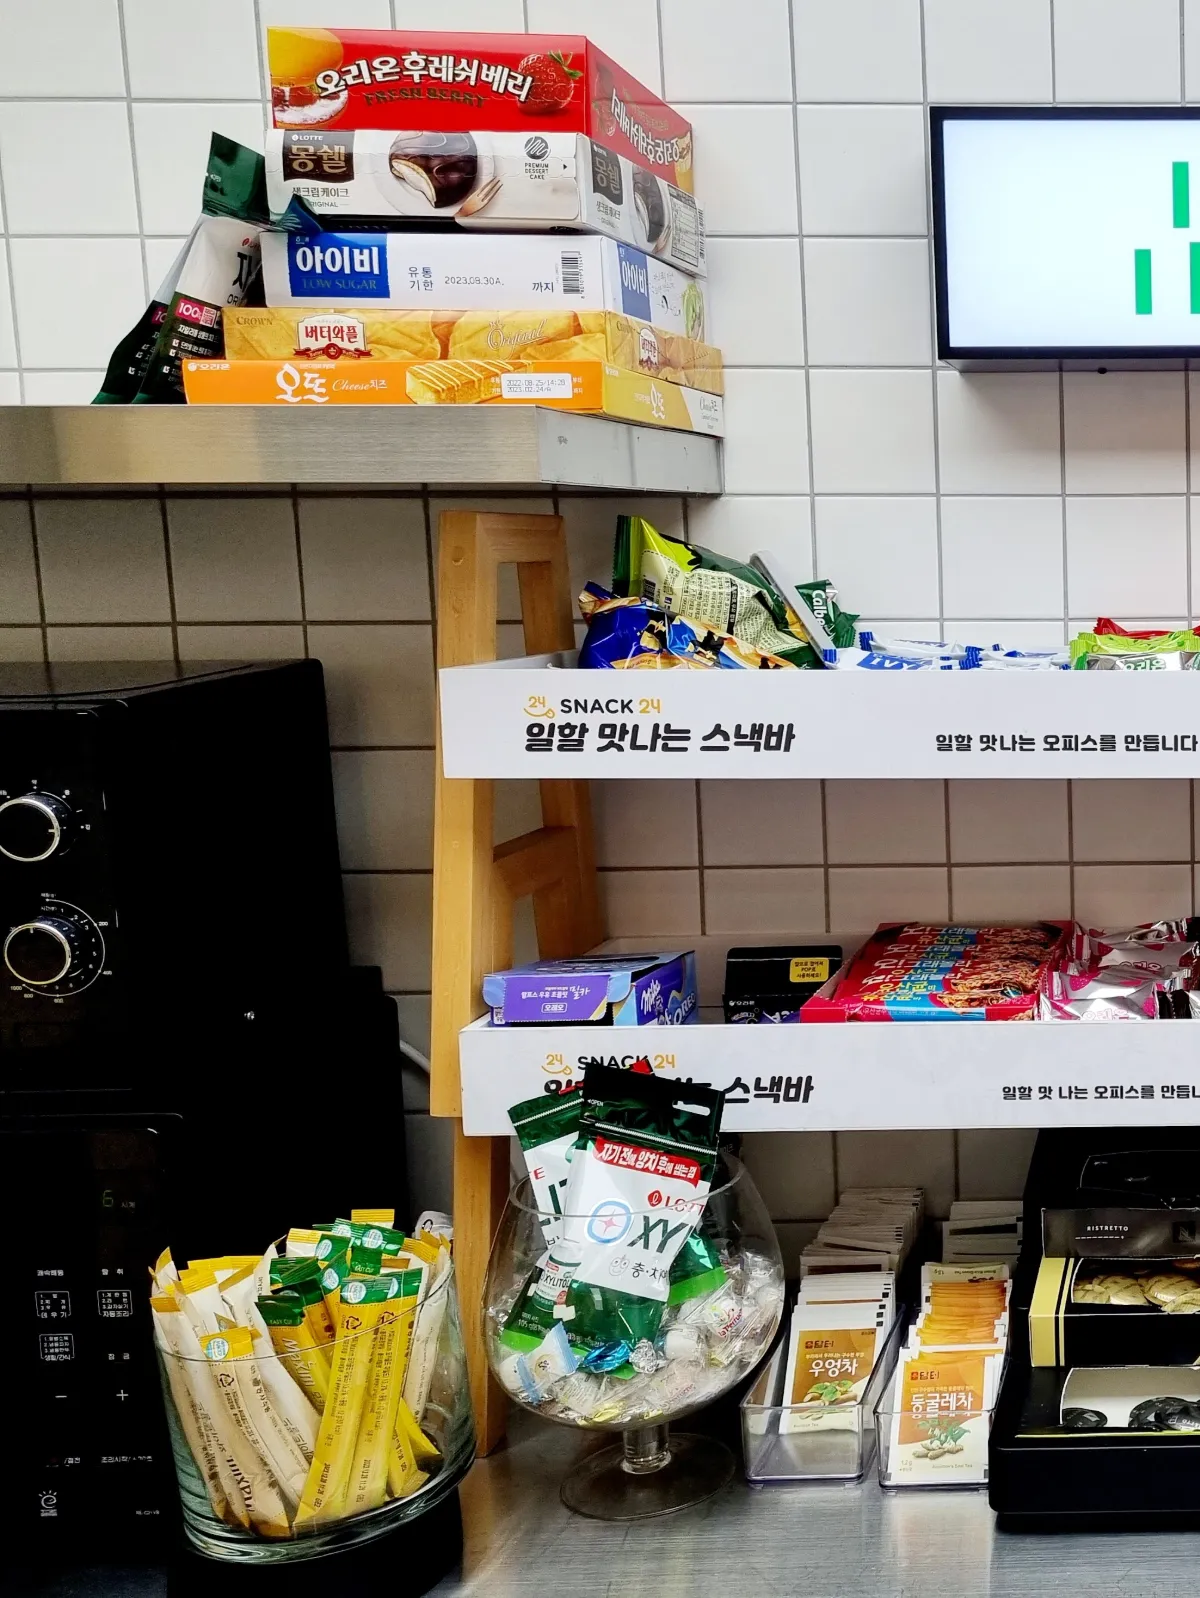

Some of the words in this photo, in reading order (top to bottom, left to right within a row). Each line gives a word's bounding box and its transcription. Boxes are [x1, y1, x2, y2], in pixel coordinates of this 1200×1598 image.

[427, 87, 485, 108] BERRY
[288, 145, 348, 174] 몽쉘
[1172, 161, 1190, 229] I
[295, 246, 379, 275] 아이비
[335, 278, 377, 290] SUGAR
[531, 281, 555, 293] 까지
[1135, 248, 1153, 315] I
[304, 325, 359, 344] 버터와플
[275, 363, 329, 403] 오뜨
[370, 379, 388, 391] 치즈
[560, 698, 634, 714] SNACK
[638, 699, 661, 714] 24
[525, 722, 590, 752] 일할
[596, 722, 692, 752] 맛나는
[700, 722, 796, 752] 스낵바
[935, 733, 973, 752] 일할
[979, 733, 1036, 752] 맛나는
[1042, 733, 1117, 752] 오피스를
[1124, 733, 1198, 752] 만듭니다
[654, 1054, 677, 1069] 24
[724, 1075, 815, 1104] 스낵바
[1002, 1084, 1032, 1101] 일할
[1094, 1084, 1155, 1101] 오피스를
[597, 1142, 621, 1164] 자기
[635, 1150, 660, 1172] 양치
[808, 1358, 859, 1378] 우엉차
[910, 1391, 974, 1419] 둥굴레차
